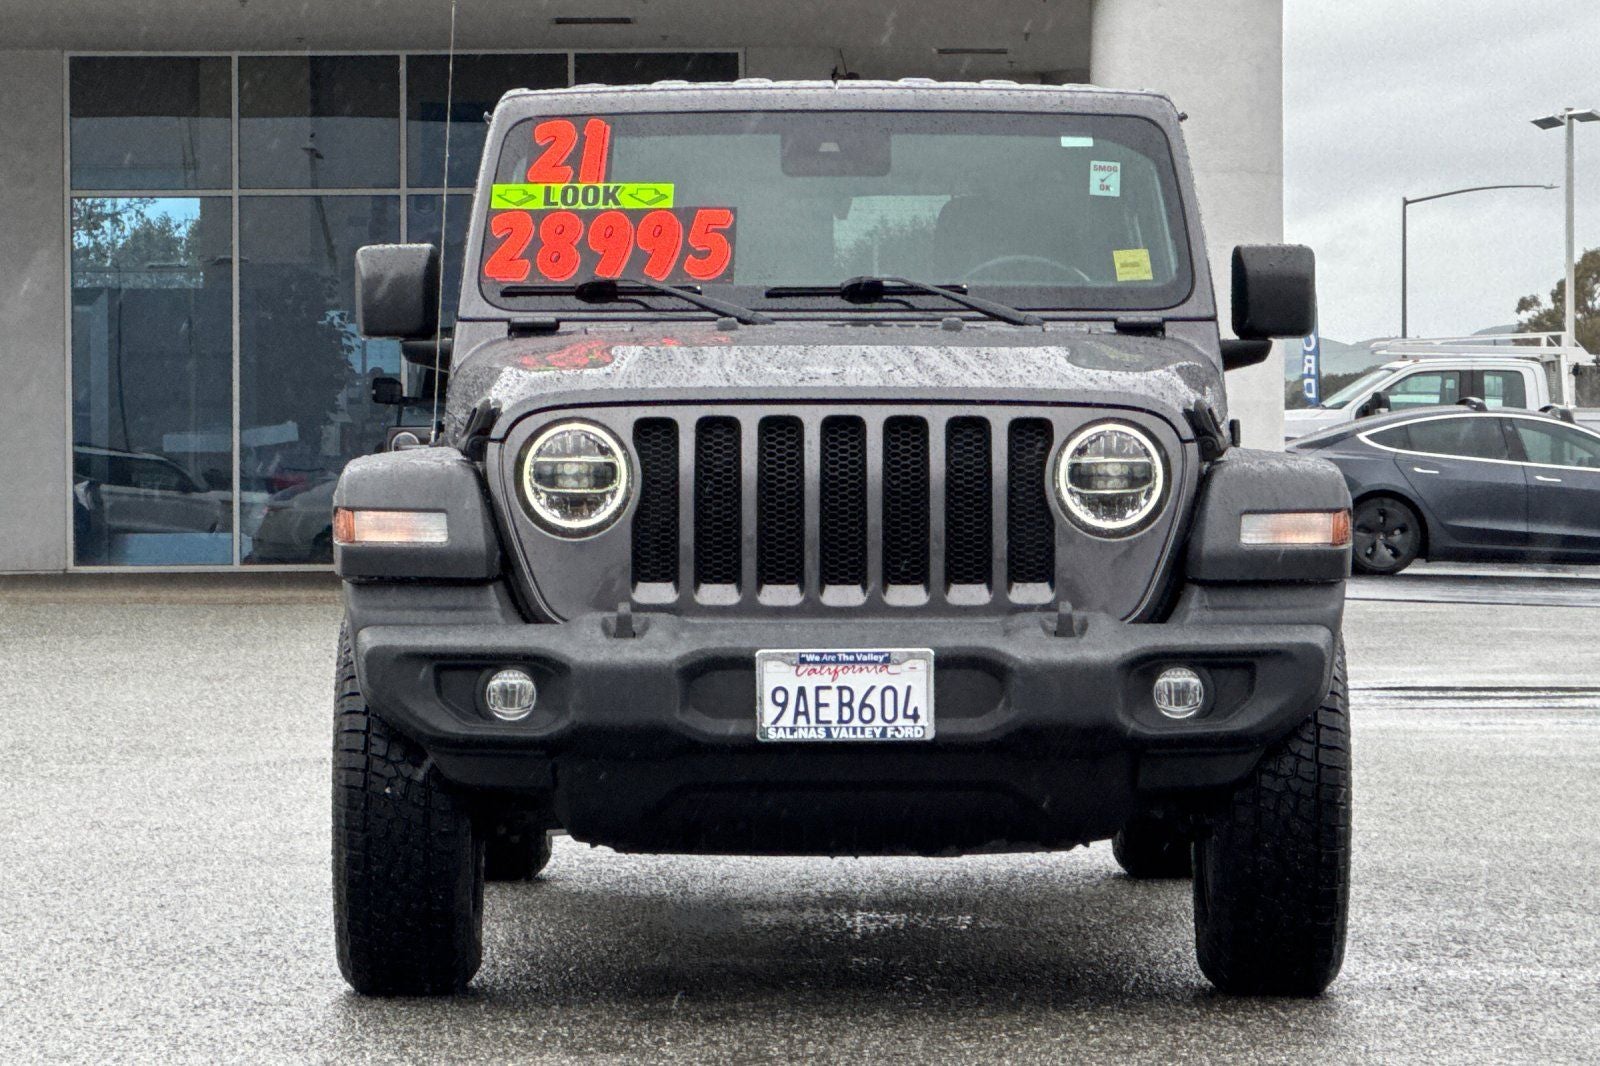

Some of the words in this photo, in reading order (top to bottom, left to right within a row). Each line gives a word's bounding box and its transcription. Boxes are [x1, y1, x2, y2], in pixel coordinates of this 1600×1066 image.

[527, 118, 610, 183] 21
[1093, 164, 1118, 172] SMOG
[543, 185, 625, 206] LOOK
[1099, 183, 1112, 192] OK
[484, 209, 734, 281] 28995
[801, 653, 820, 662] "We
[822, 653, 836, 662] Are
[837, 653, 856, 662] The
[856, 653, 889, 664] Valley"
[795, 664, 901, 682] California
[770, 685, 921, 725] 9AEB604
[768, 727, 826, 739] SALINAS
[831, 727, 883, 739] VALLEY
[887, 727, 924, 739] FORD
